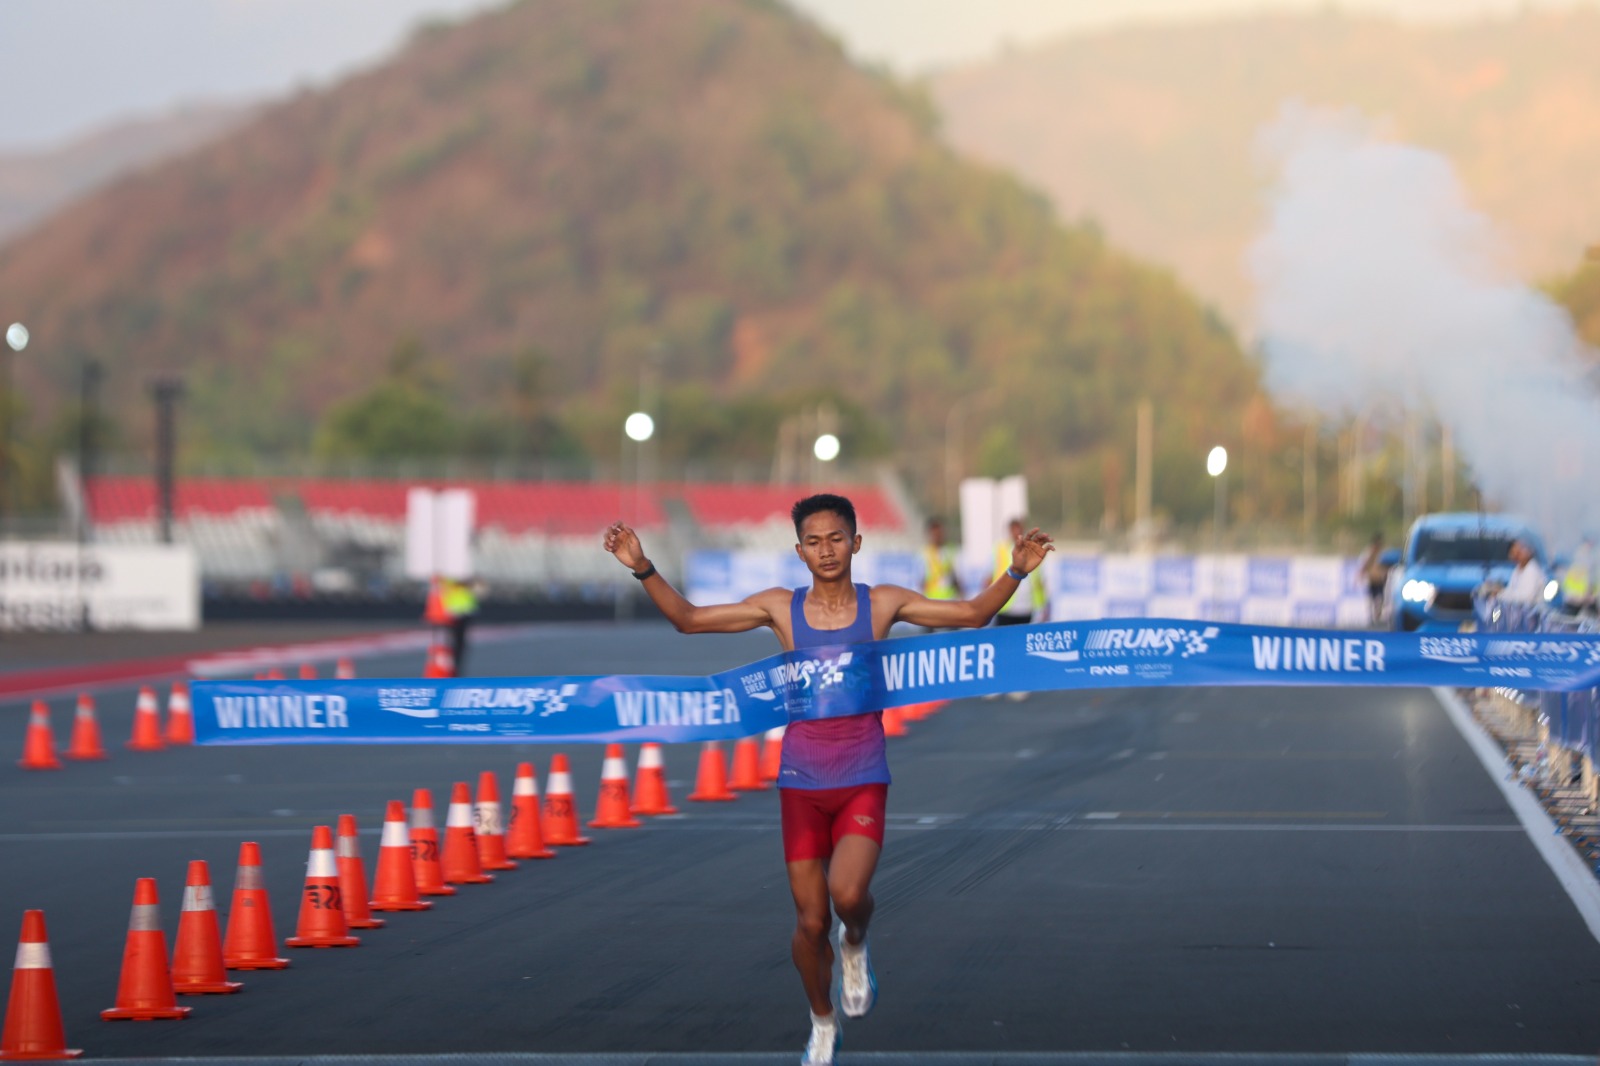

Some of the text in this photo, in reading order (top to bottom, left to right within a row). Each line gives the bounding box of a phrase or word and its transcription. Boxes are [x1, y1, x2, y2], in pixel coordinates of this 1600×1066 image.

[1026, 630, 1077, 643] POCARI
[1420, 637, 1478, 649] POCARI
[1026, 640, 1073, 652] SWEAT
[1420, 645, 1471, 656] SWEAT
[1252, 635, 1386, 672] WINNER
[882, 643, 995, 692] WINNER
[740, 671, 767, 686] POCARI
[377, 688, 437, 698] POCARI
[745, 680, 768, 695] SWEAT
[378, 698, 431, 708] SWEAT
[613, 688, 741, 727] WINNER
[212, 695, 349, 728] WINNER
